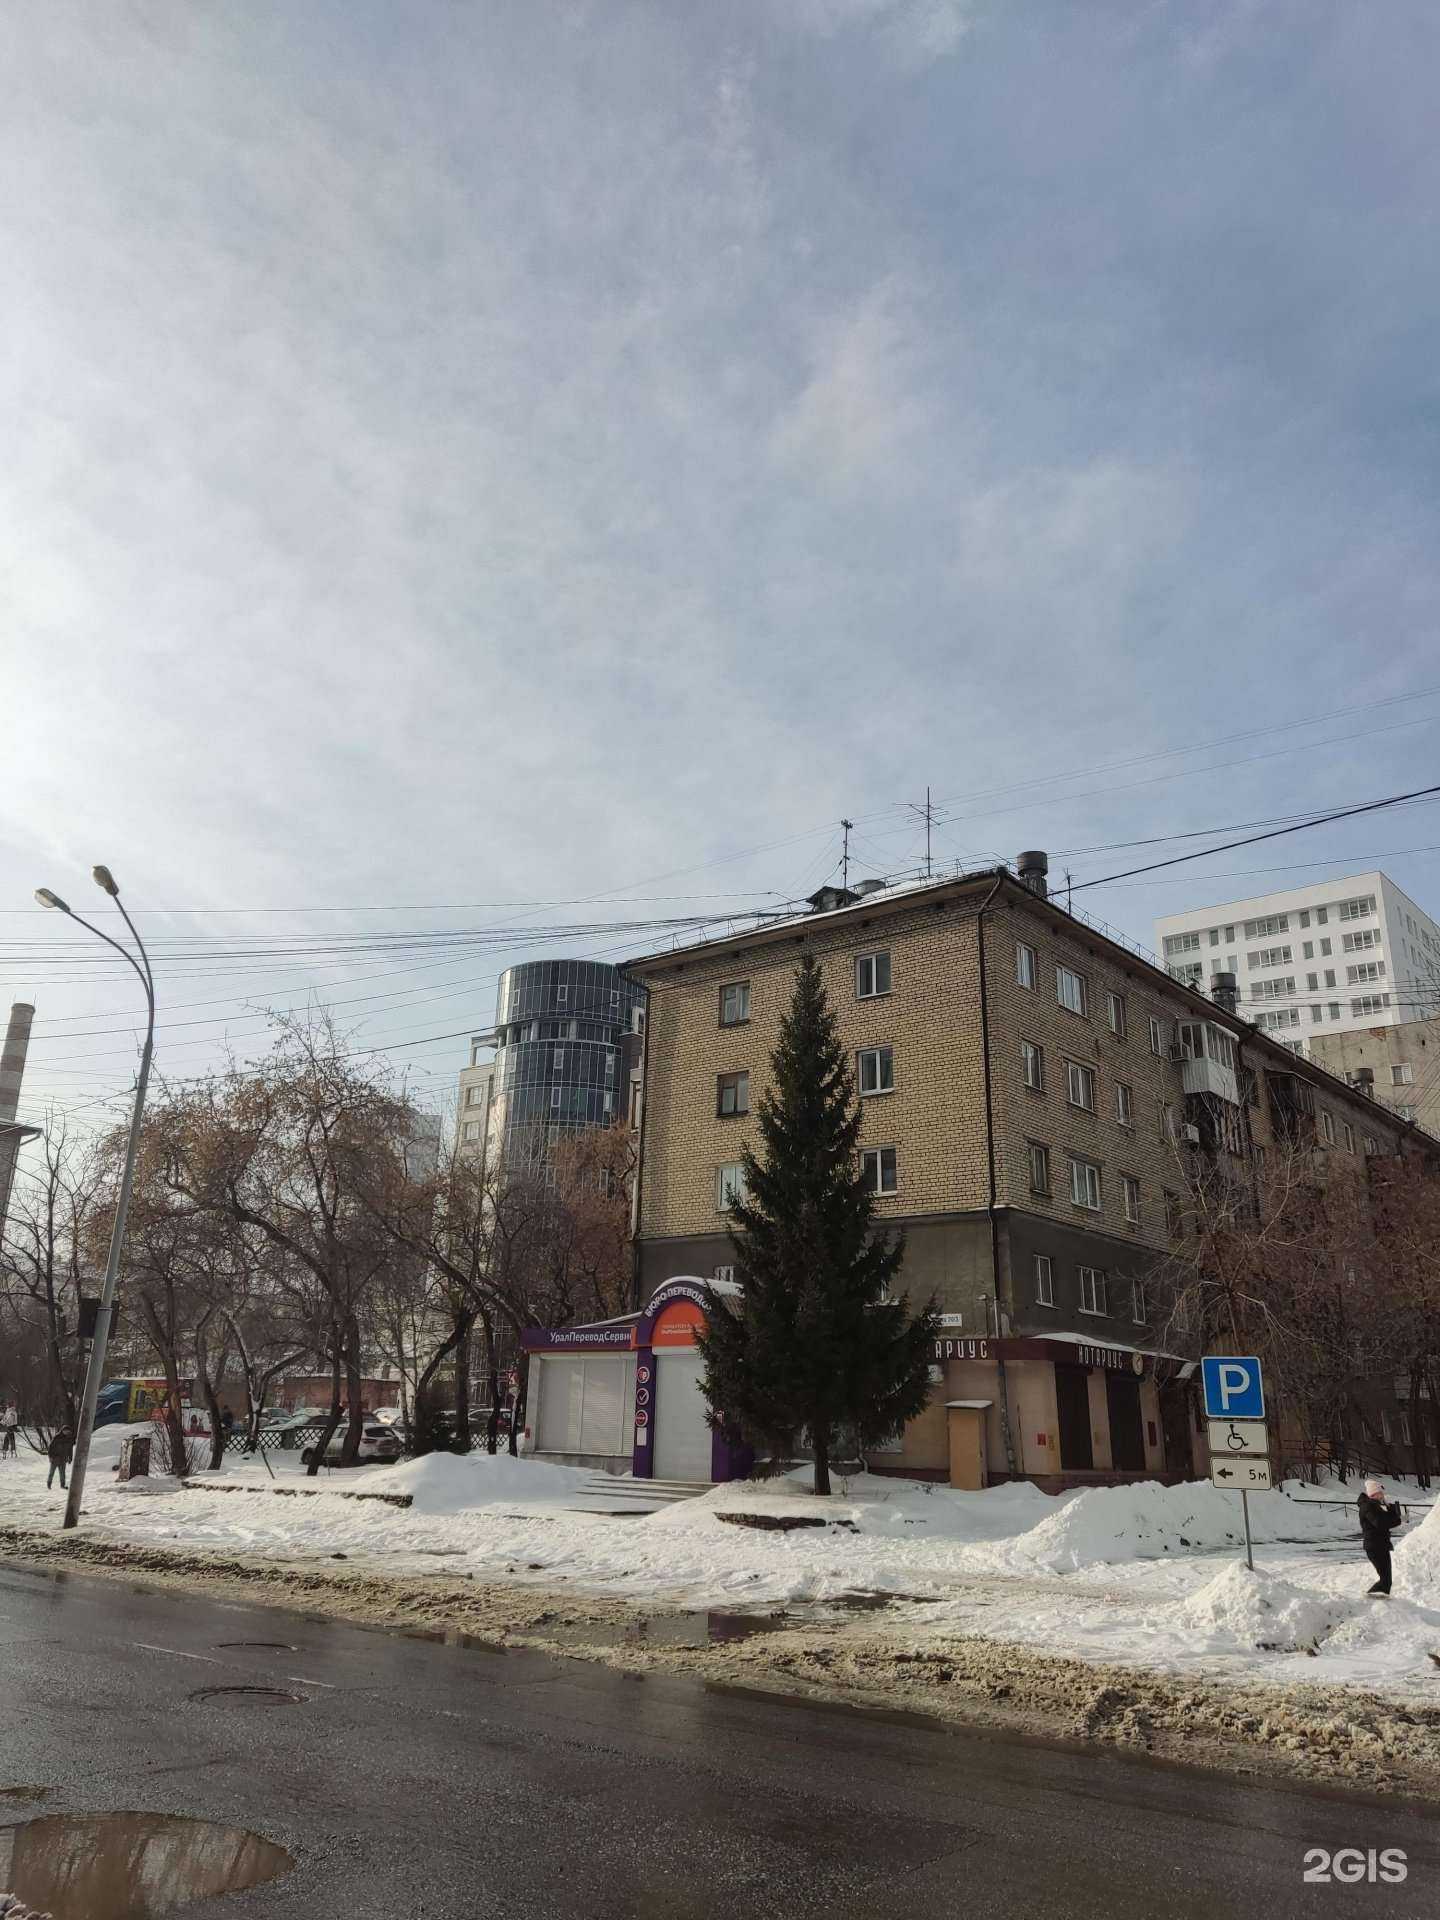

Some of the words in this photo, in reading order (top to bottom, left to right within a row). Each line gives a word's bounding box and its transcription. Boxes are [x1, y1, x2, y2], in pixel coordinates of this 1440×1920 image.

[644, 1292, 667, 1317] БЮРО
[935, 1340, 987, 1359] АРИУС
[1078, 1344, 1122, 1368] НОТАРИУС
[1218, 1364, 1250, 1410] P
